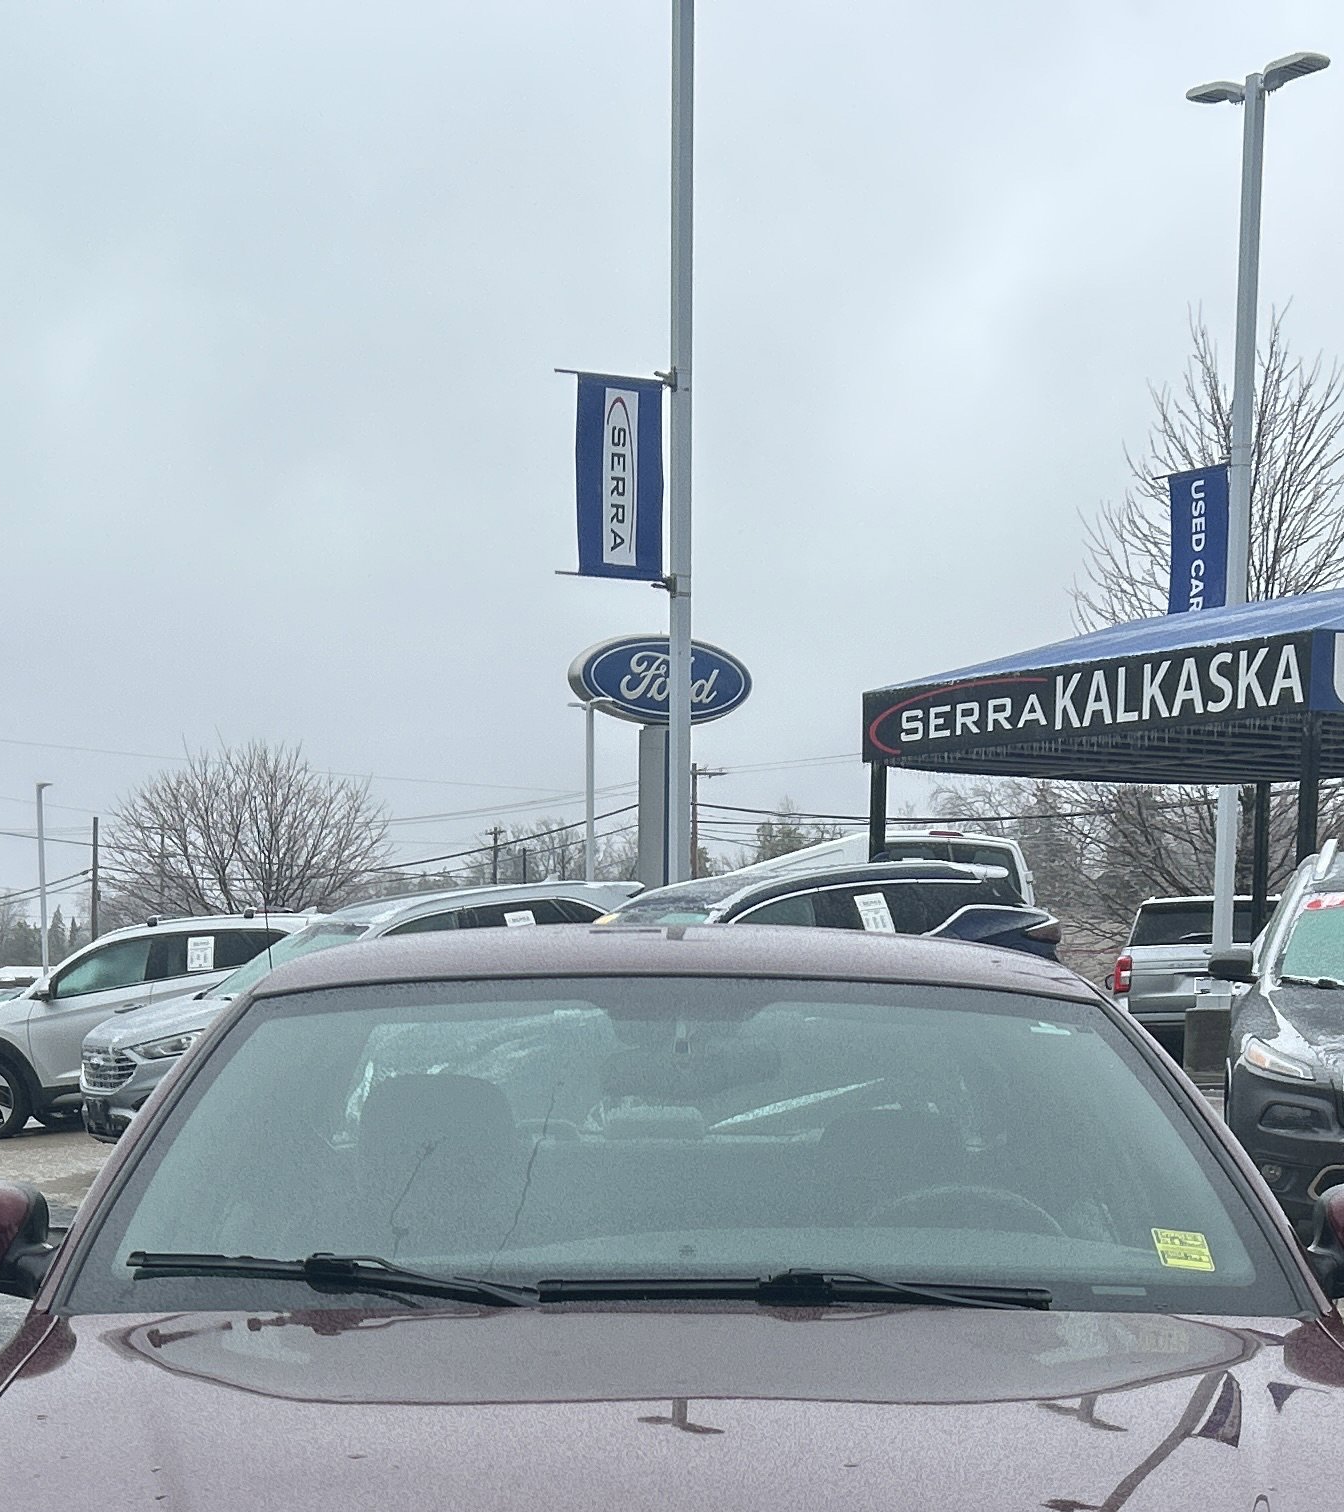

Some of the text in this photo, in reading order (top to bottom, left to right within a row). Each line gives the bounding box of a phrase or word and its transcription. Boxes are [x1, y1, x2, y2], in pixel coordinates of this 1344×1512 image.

[609, 425, 626, 552] SERRA
[1189, 479, 1206, 612] USED CAR
[619, 651, 720, 704] Fod
[899, 643, 1305, 743] SERRA KALKASKA
